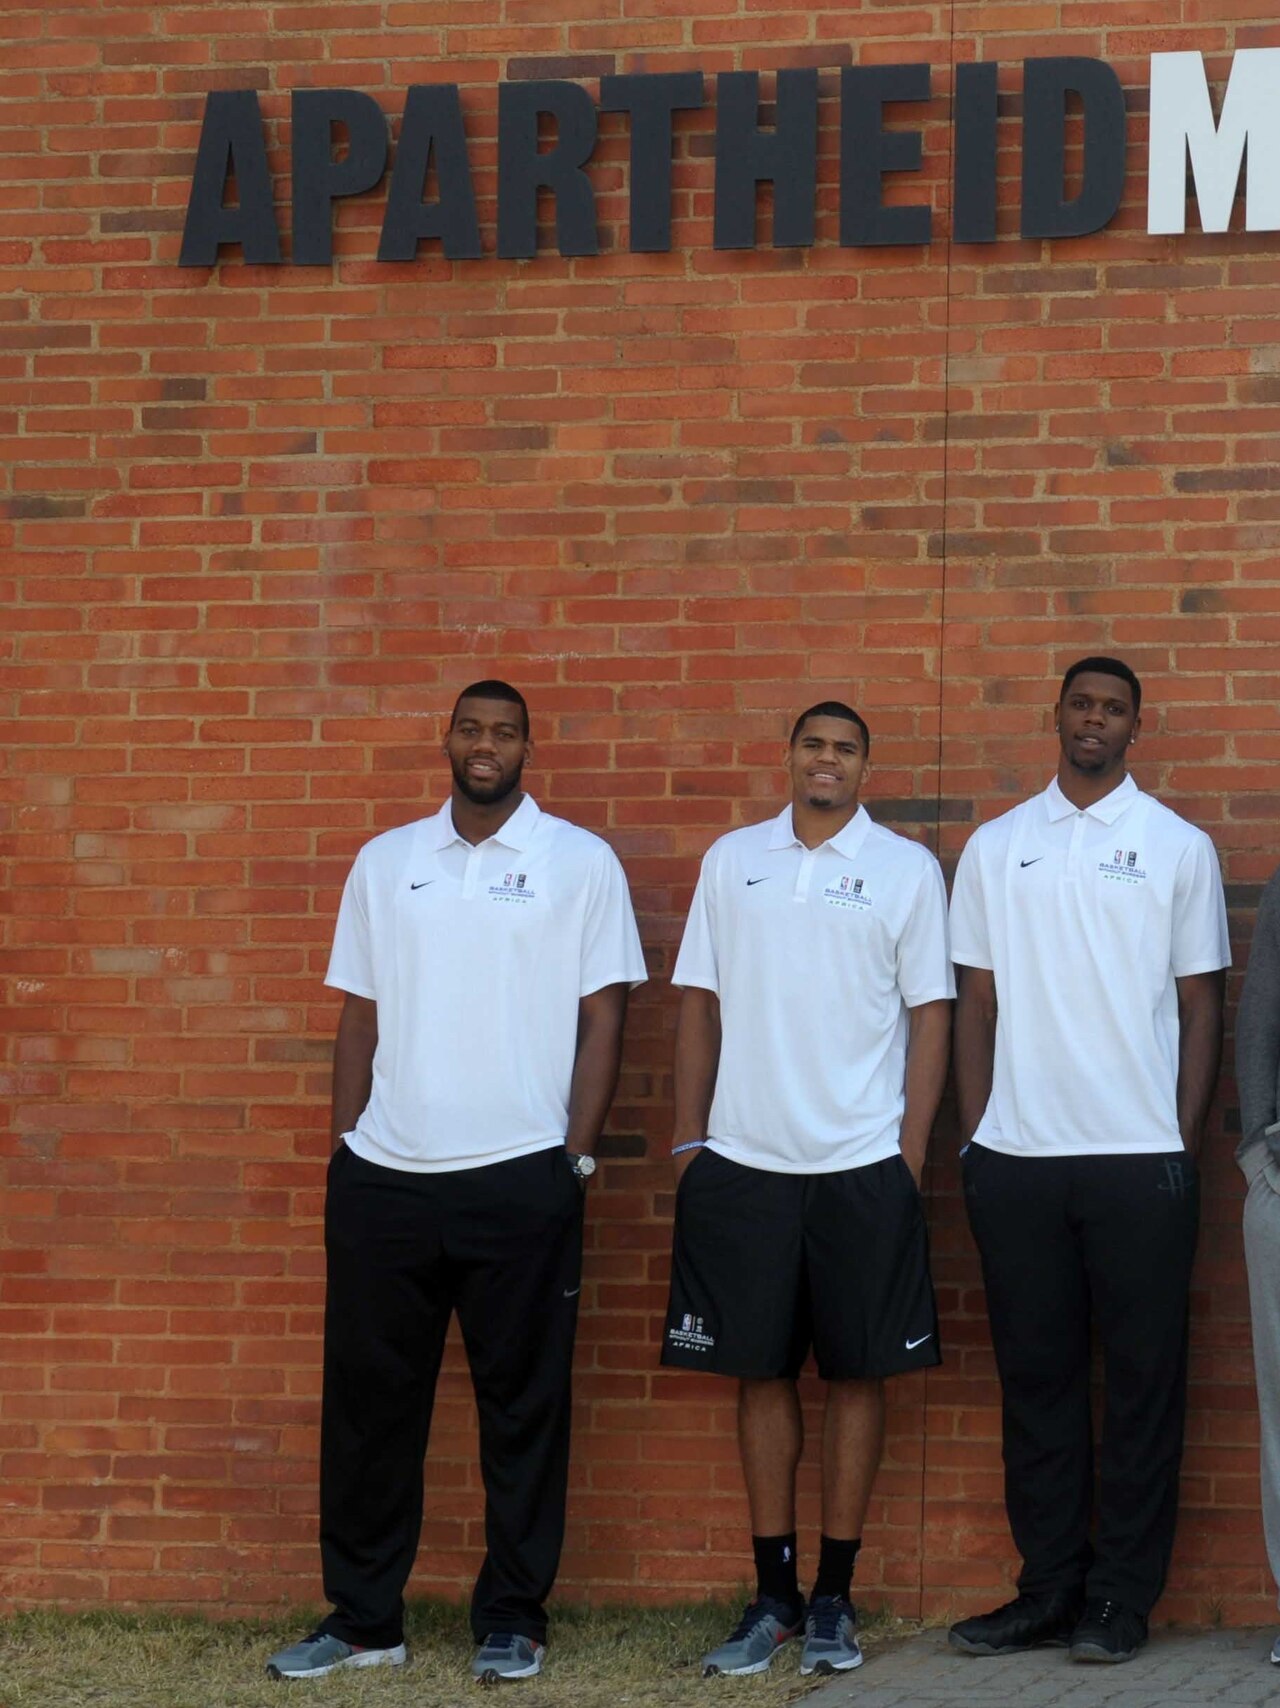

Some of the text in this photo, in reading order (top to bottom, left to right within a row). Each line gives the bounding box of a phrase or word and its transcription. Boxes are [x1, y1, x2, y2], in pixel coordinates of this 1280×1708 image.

[179, 56, 1126, 268] APARTHEID
[1099, 862, 1147, 875] BASKETBALL
[1103, 874, 1139, 884] AFRICA
[488, 886, 536, 895] BASKETBALL
[824, 888, 872, 902] BASKETBALL
[669, 1328, 715, 1343] BASKETBALL
[673, 1341, 707, 1352] AFRICA
